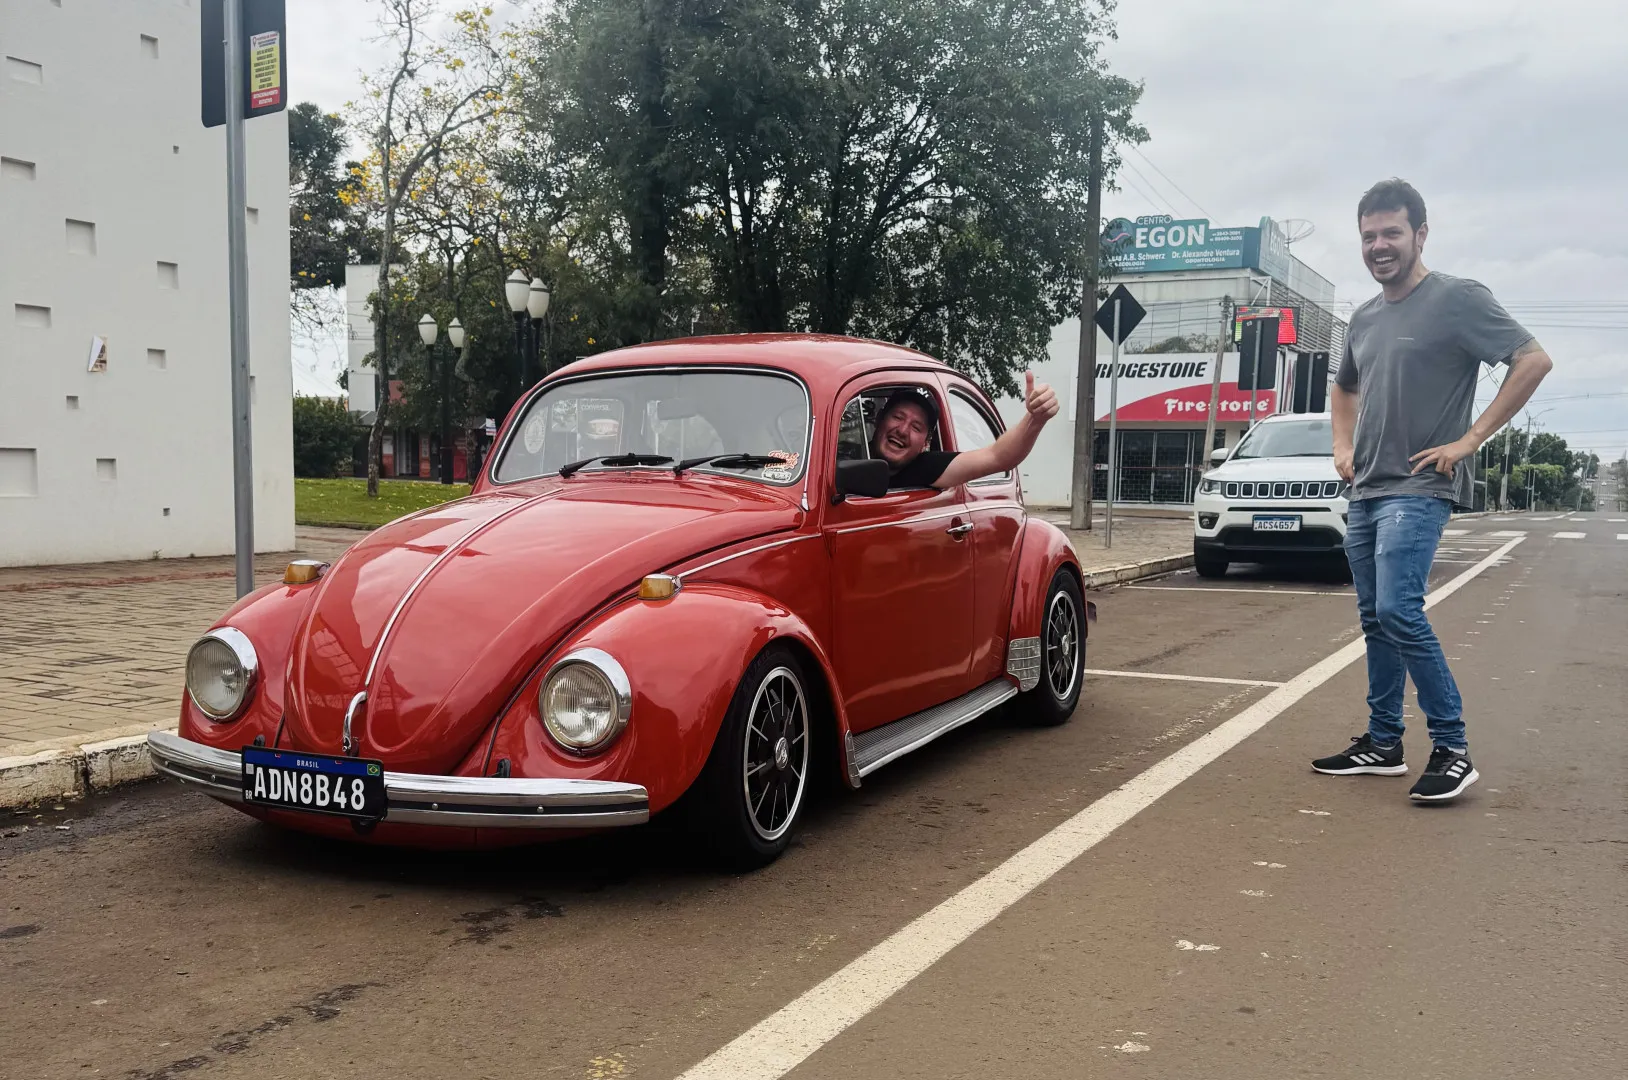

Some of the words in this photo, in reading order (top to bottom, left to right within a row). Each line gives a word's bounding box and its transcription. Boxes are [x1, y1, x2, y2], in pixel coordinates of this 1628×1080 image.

[1137, 215, 1172, 226] CENTRO
[1135, 224, 1206, 248] EGON
[1137, 252, 1166, 261] Schwerz
[1171, 251, 1181, 259] Dr.
[1181, 249, 1214, 259] Alexandre
[1214, 248, 1240, 256] Ventura
[1096, 361, 1207, 379] RIDGESTONE
[1164, 398, 1268, 415] Firetone
[296, 759, 319, 768] BRASIL
[254, 766, 365, 810] ADN8B48
[245, 789, 253, 800] BR
